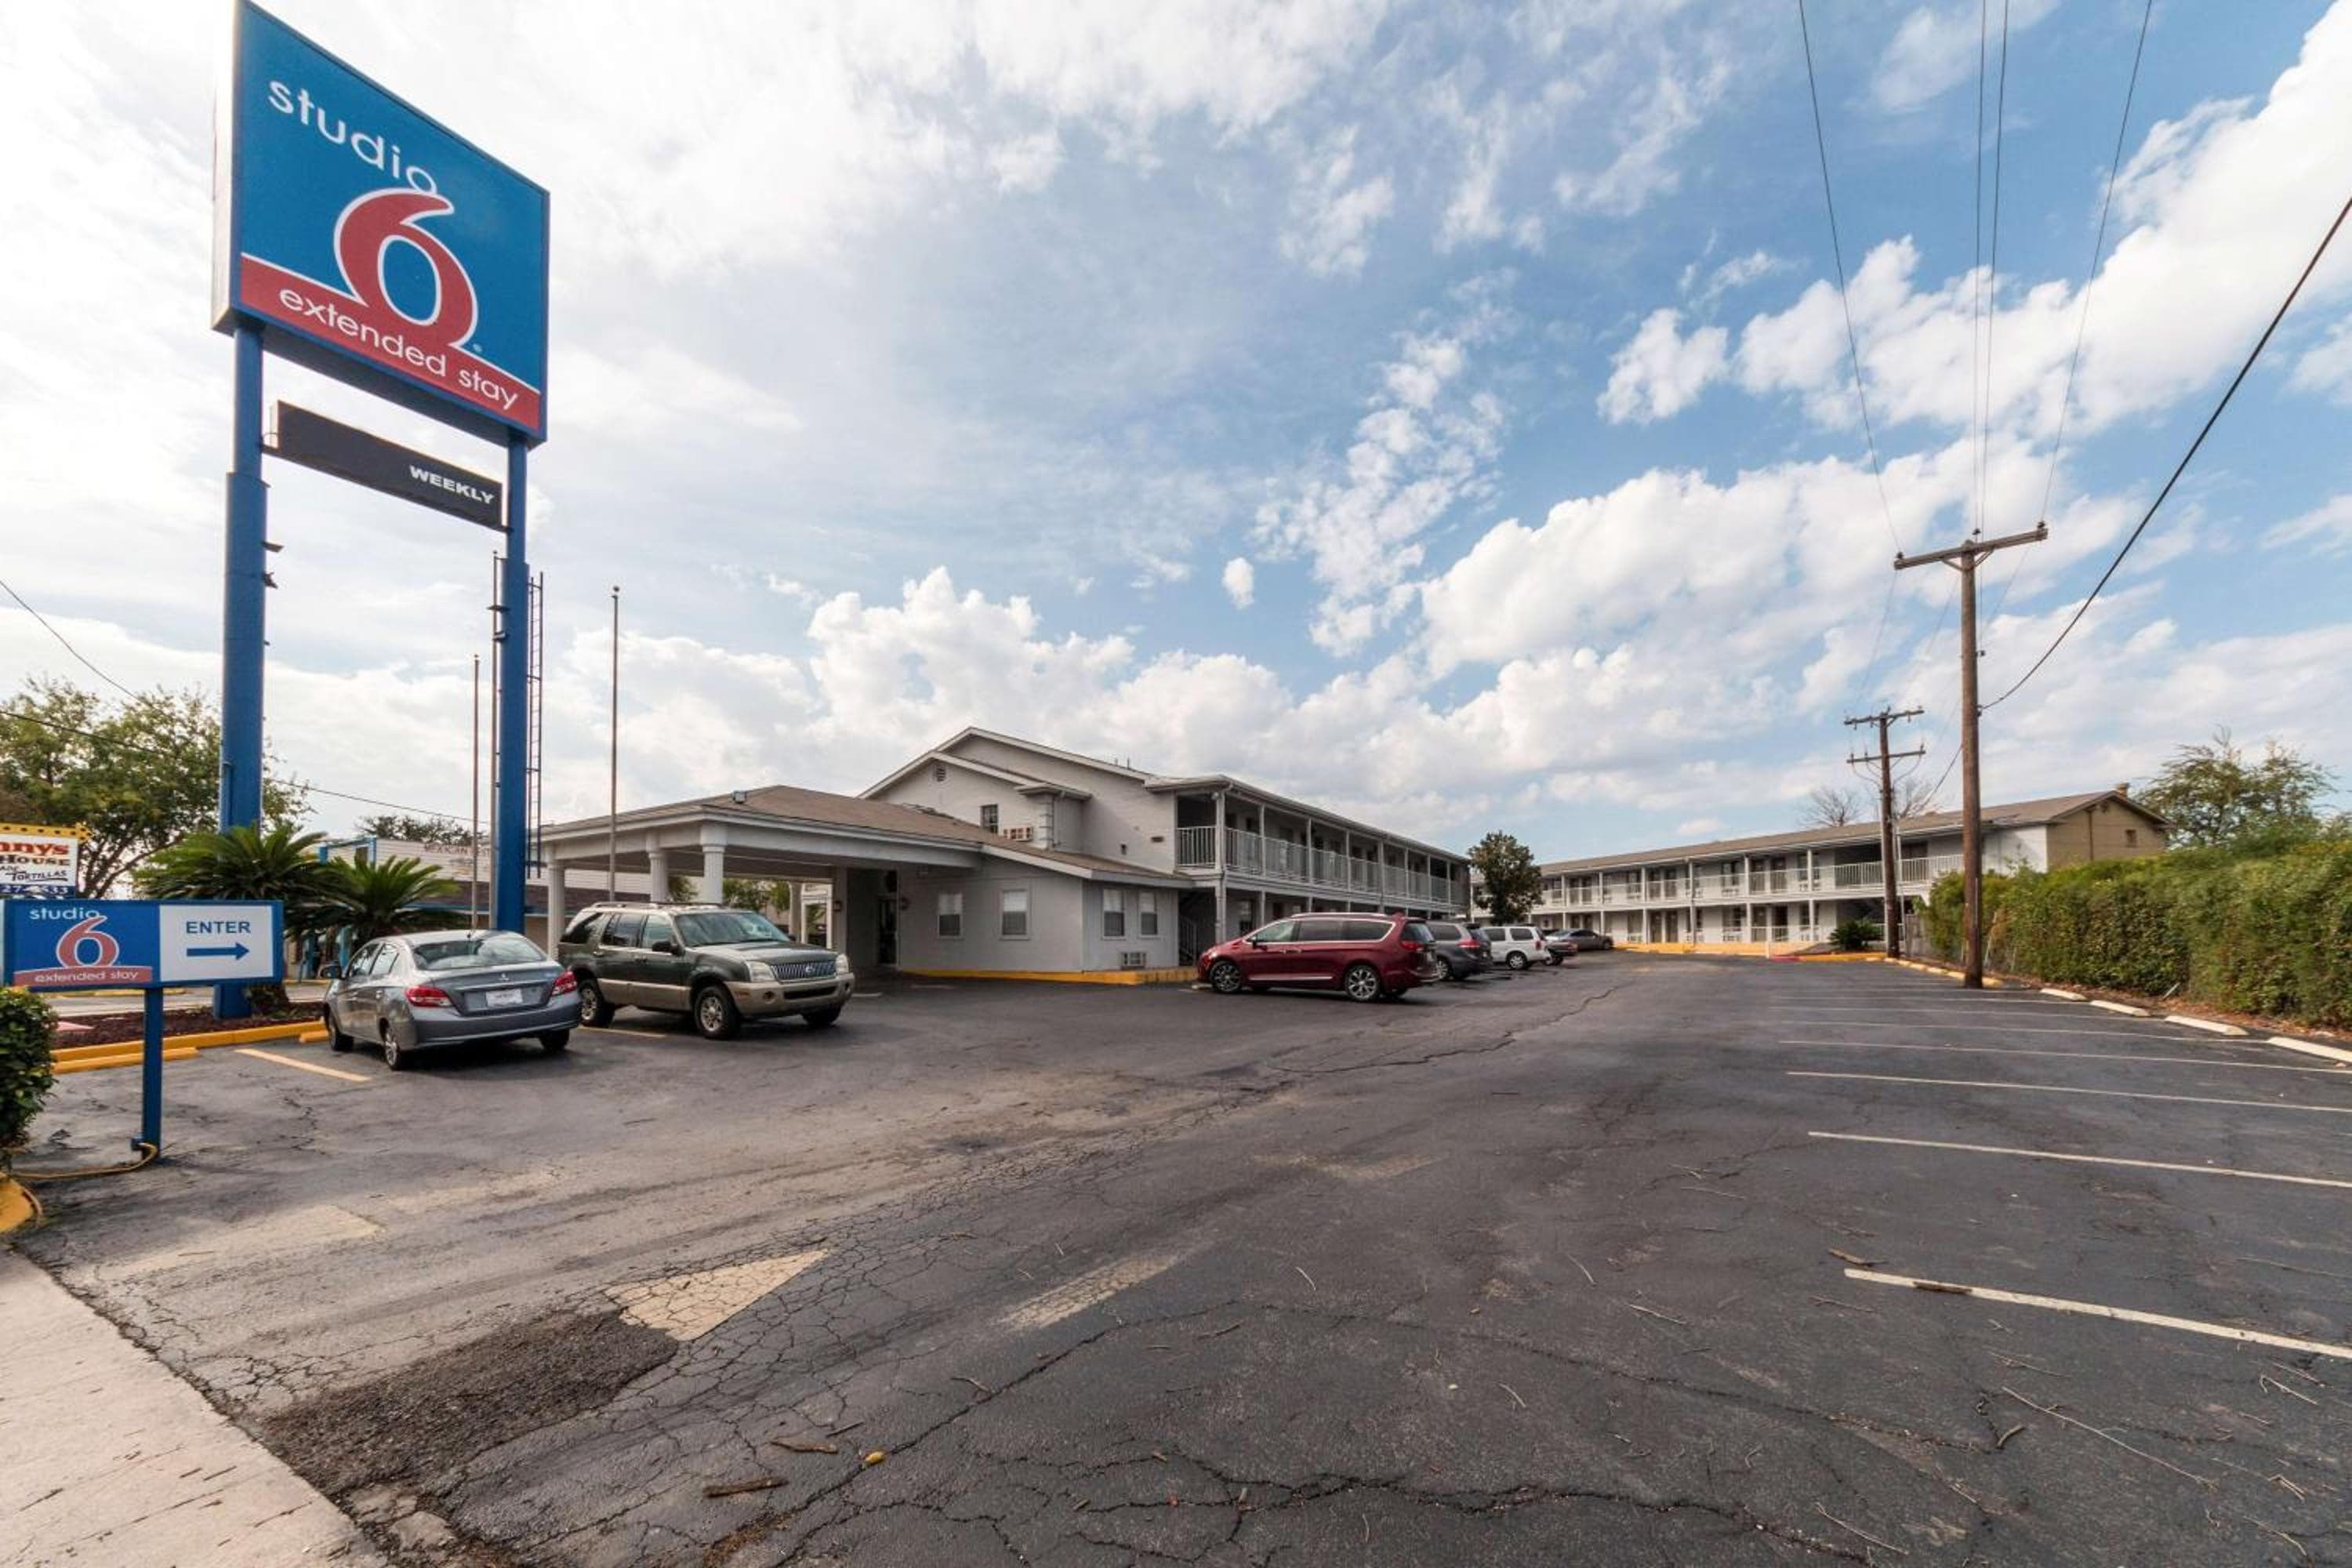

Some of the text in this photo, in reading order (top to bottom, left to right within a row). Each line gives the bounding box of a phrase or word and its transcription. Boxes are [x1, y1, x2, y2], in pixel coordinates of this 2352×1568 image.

[267, 81, 437, 195] studio
[334, 187, 478, 347] 6
[279, 289, 518, 410] extended stay
[409, 465, 495, 504] WEEKLY
[29, 907, 100, 920] studio
[186, 921, 251, 934] ENTER
[56, 915, 119, 968] 6
[34, 970, 139, 982] extended stay
